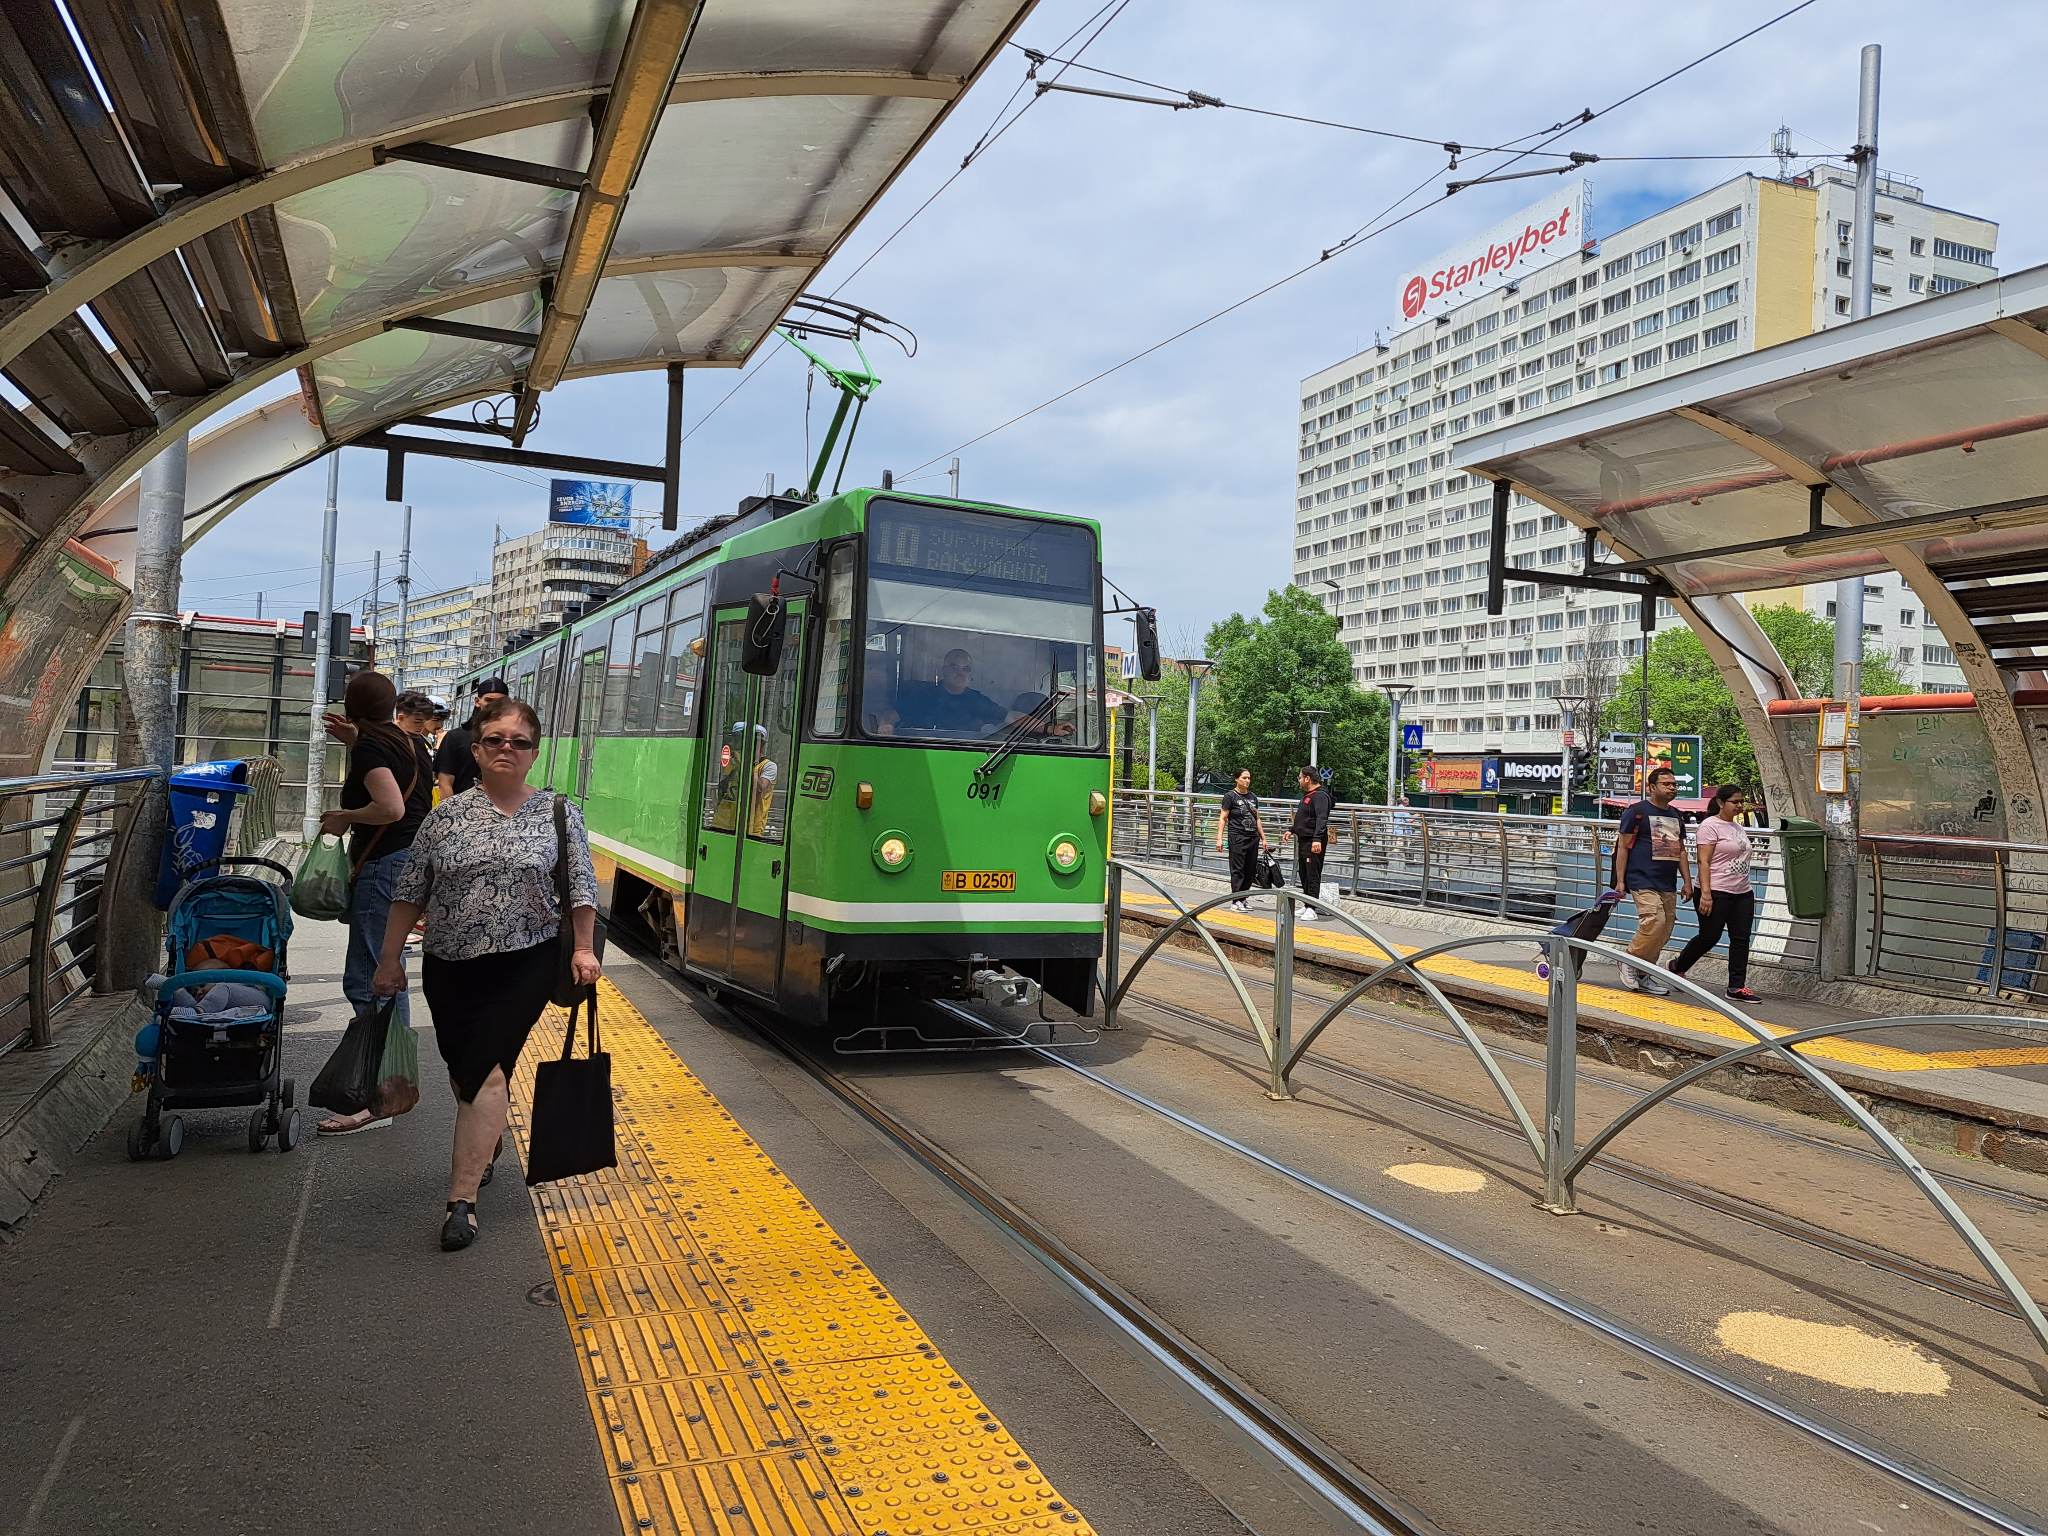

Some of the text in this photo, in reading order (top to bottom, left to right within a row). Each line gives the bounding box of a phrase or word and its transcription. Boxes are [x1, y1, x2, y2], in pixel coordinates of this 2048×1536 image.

[1429, 207, 1570, 299] Stanleybet
[877, 520, 920, 567] 10
[1124, 655, 1135, 676] M
[801, 771, 832, 793] STB
[967, 783, 1001, 801] 091
[956, 873, 1014, 889] B 02501
